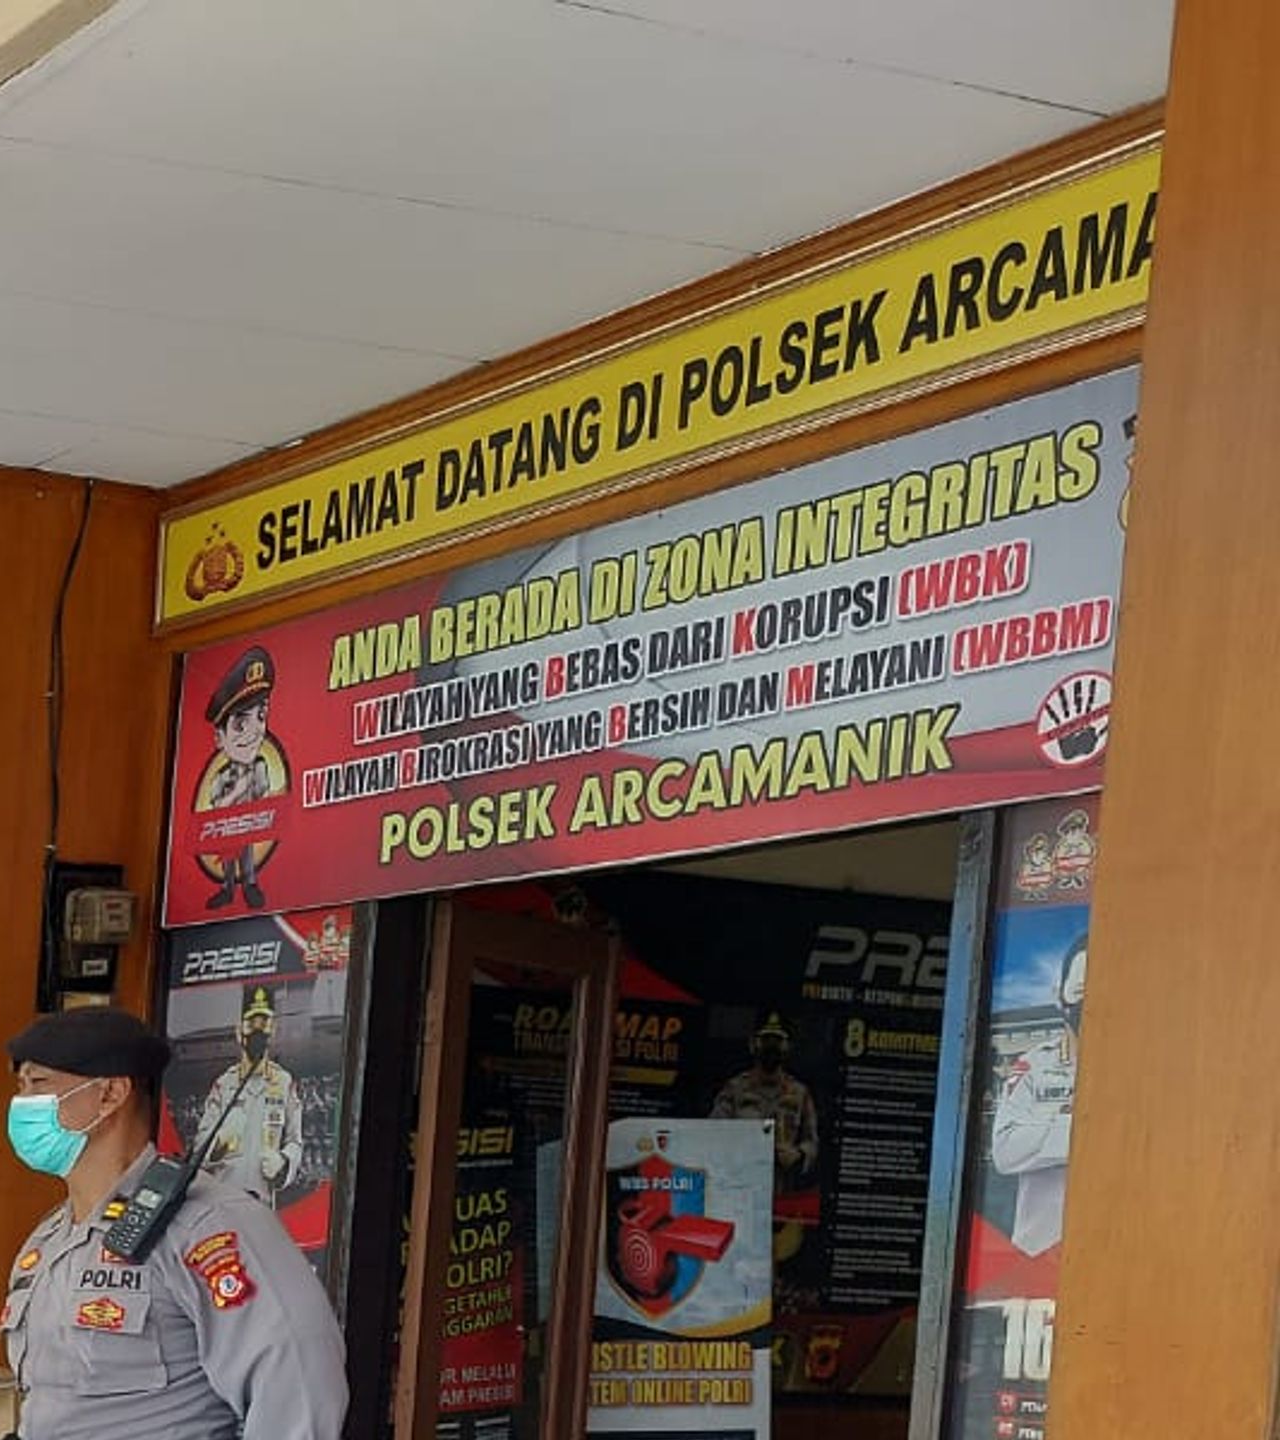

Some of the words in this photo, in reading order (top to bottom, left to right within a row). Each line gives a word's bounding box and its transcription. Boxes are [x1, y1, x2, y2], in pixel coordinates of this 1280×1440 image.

[256, 459, 425, 571] SELAMAT
[434, 398, 602, 512] DATANG
[616, 372, 664, 451] DI
[678, 289, 888, 431] POLSEK
[328, 613, 421, 691] ANDA
[428, 566, 583, 666] BERADA
[587, 553, 637, 627] DI
[641, 516, 766, 611] ZONA
[772, 422, 1103, 578] INTEGRITAS
[354, 676, 467, 745] WILAYAH
[467, 660, 540, 716] YANG
[544, 636, 642, 700] BEBAS
[646, 615, 726, 679] DARI
[730, 573, 891, 660] KORUPSI
[302, 757, 398, 808] WILAYAH
[398, 723, 531, 788] BIROKRASI
[536, 707, 606, 763] YANG
[606, 685, 712, 745] BERSIH
[715, 671, 780, 727] DAN
[784, 633, 948, 715] MELAYANI
[378, 783, 559, 865] POLSEK
[568, 702, 963, 834] ARCAMANIK
[199, 810, 277, 842] PRESISI
[183, 940, 282, 975] PRESISI
[845, 1019, 866, 1058] 8
[80, 1269, 141, 1290] POLRI
[652, 1340, 753, 1371] BLOWING
[631, 1379, 696, 1405] ONLINE
[699, 1377, 752, 1404] POLRI
